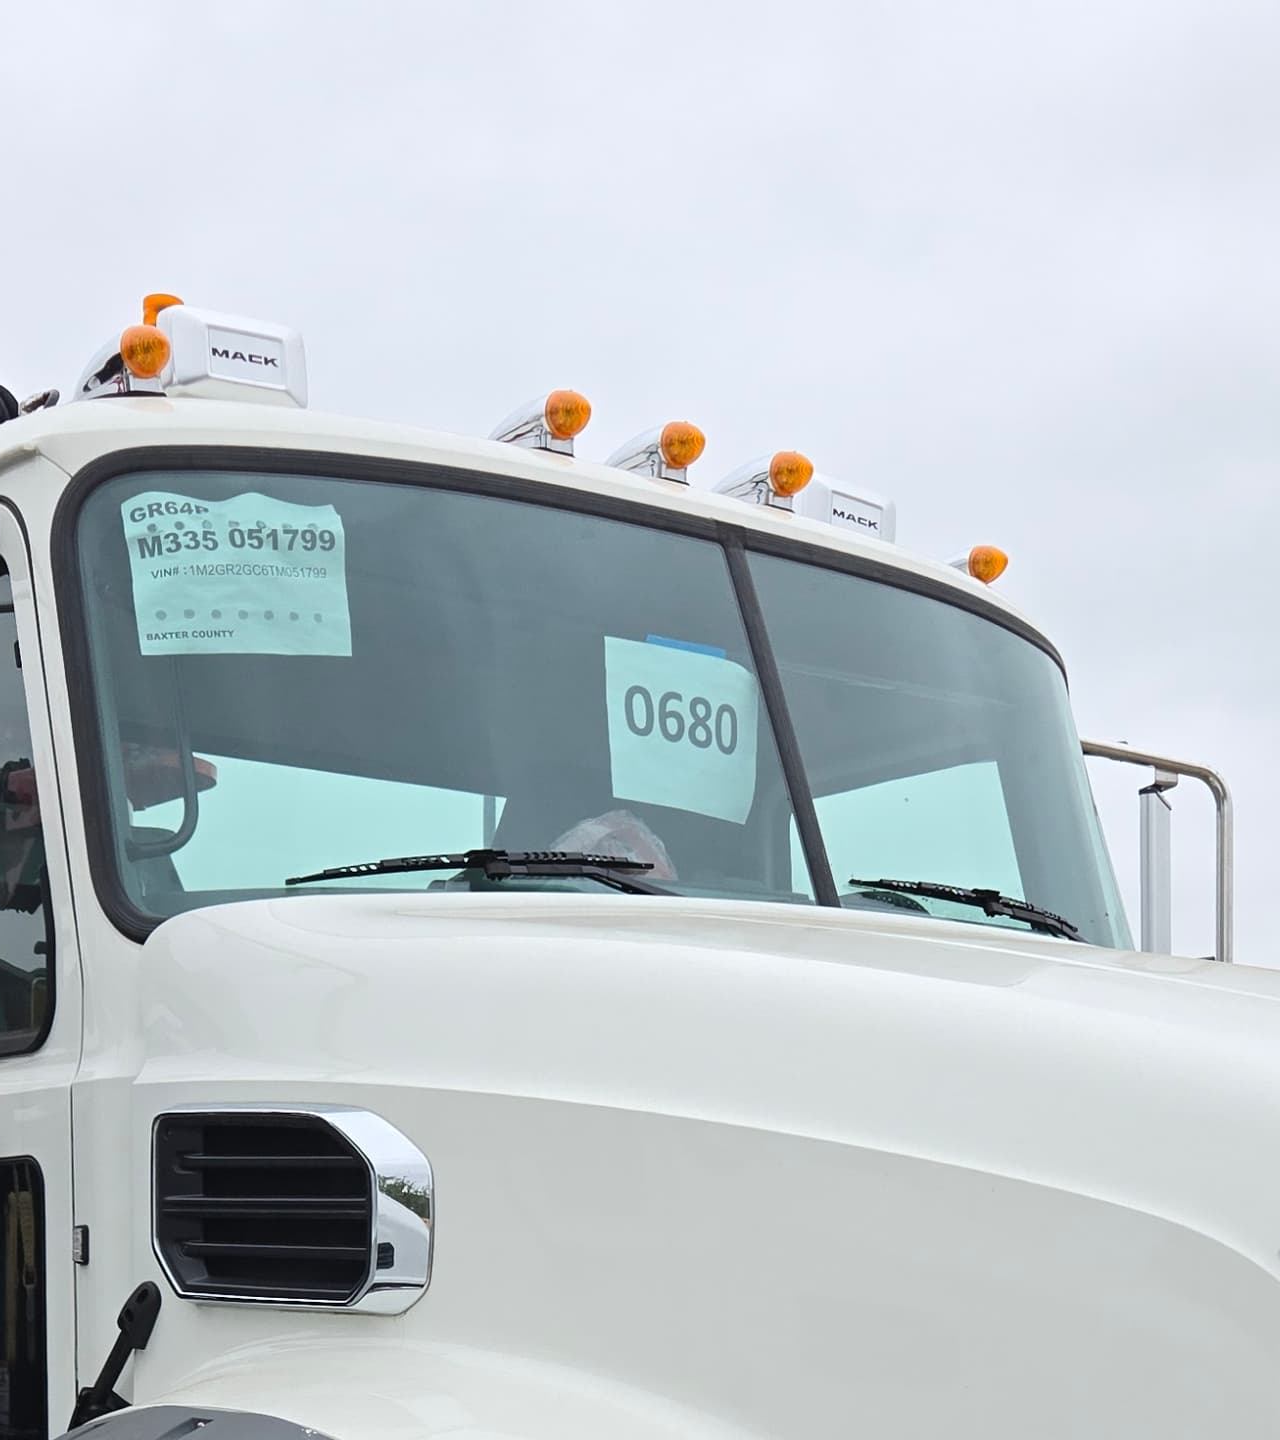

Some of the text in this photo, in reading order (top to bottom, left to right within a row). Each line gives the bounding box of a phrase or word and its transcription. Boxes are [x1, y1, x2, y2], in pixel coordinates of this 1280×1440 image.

[210, 346, 279, 368] MACK
[832, 508, 879, 530] MACK
[137, 528, 336, 559] M335 051799
[146, 629, 235, 641] BAXTER COUNTY
[624, 684, 738, 756] 0680
